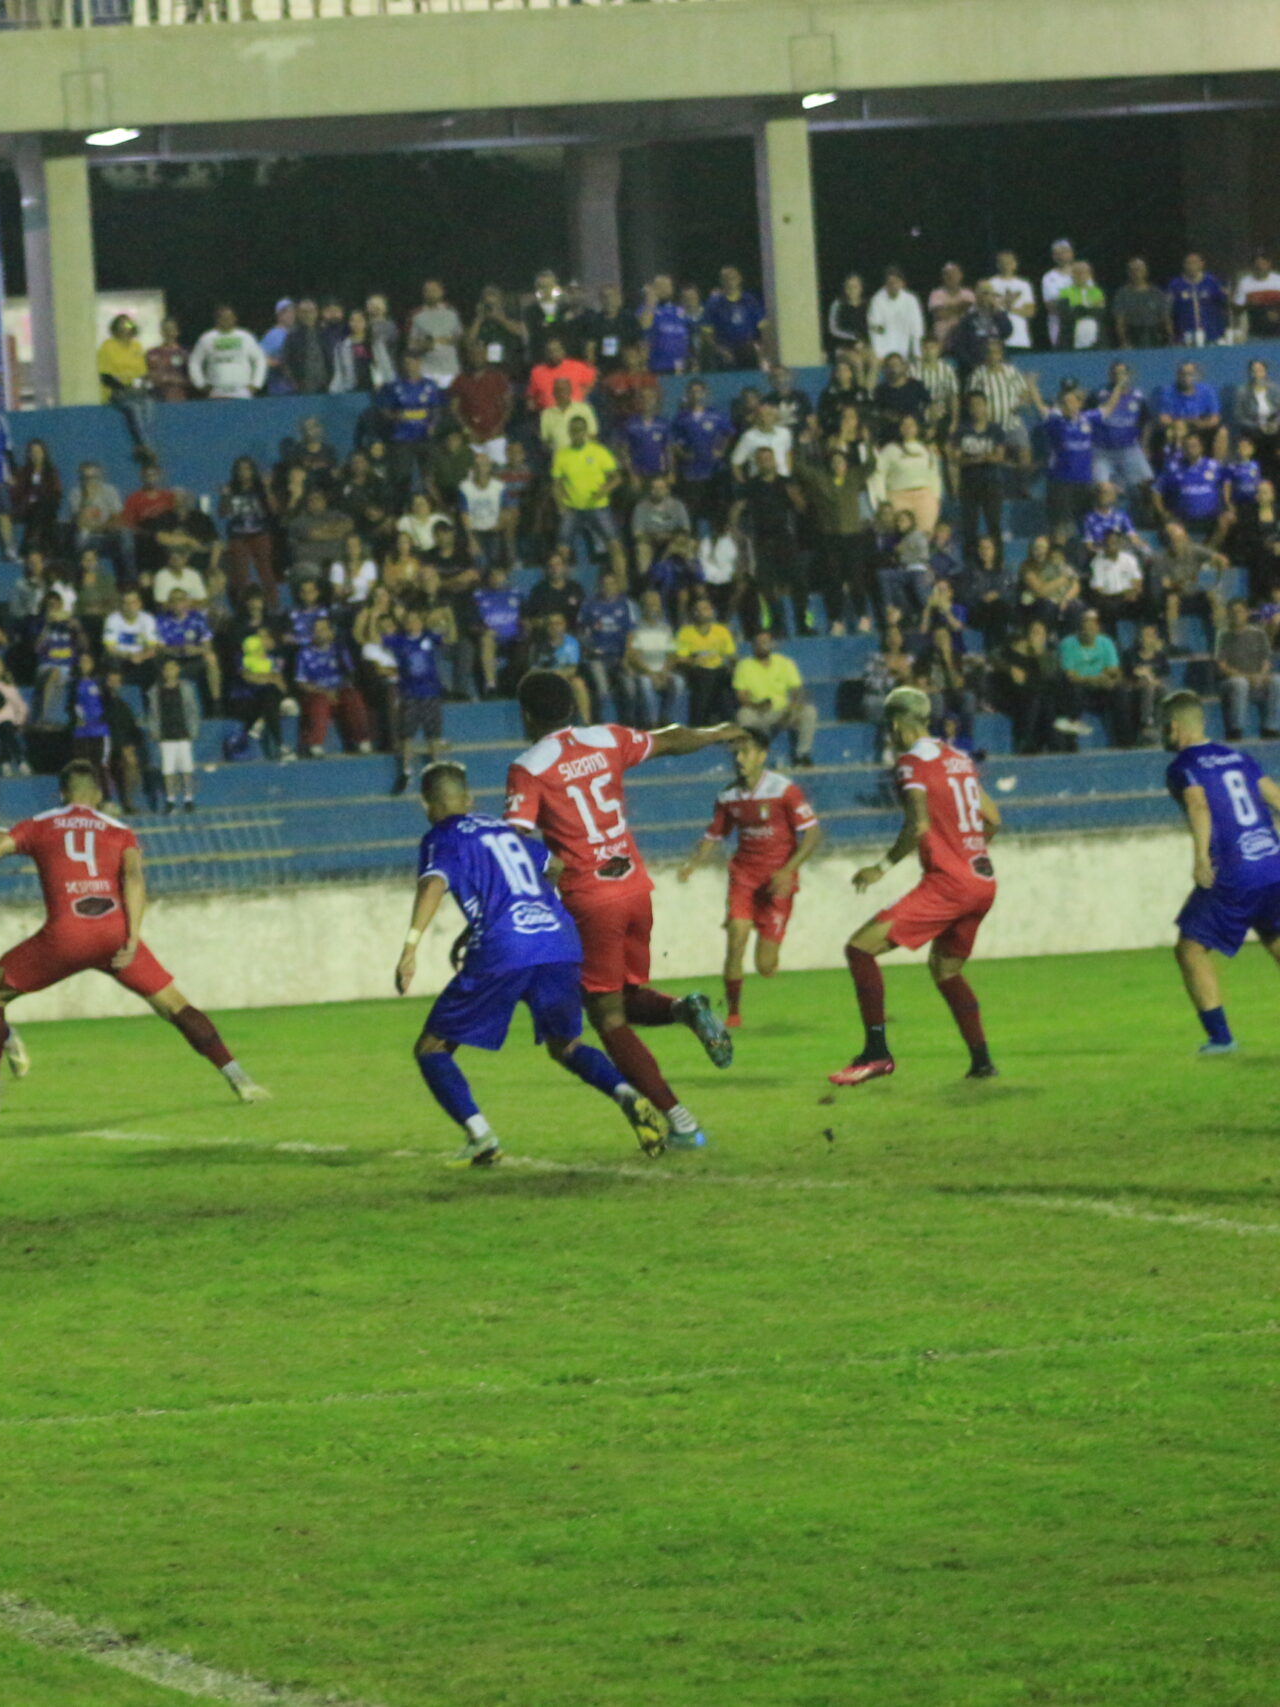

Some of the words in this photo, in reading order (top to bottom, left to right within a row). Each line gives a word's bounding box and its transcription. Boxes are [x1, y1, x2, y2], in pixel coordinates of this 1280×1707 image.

[557, 752, 609, 783] SUZANO
[53, 817, 107, 831] SUZANO
[566, 772, 627, 845] 15
[1222, 770, 1259, 827] 8
[64, 830, 99, 877] 4
[480, 833, 542, 896] 18
